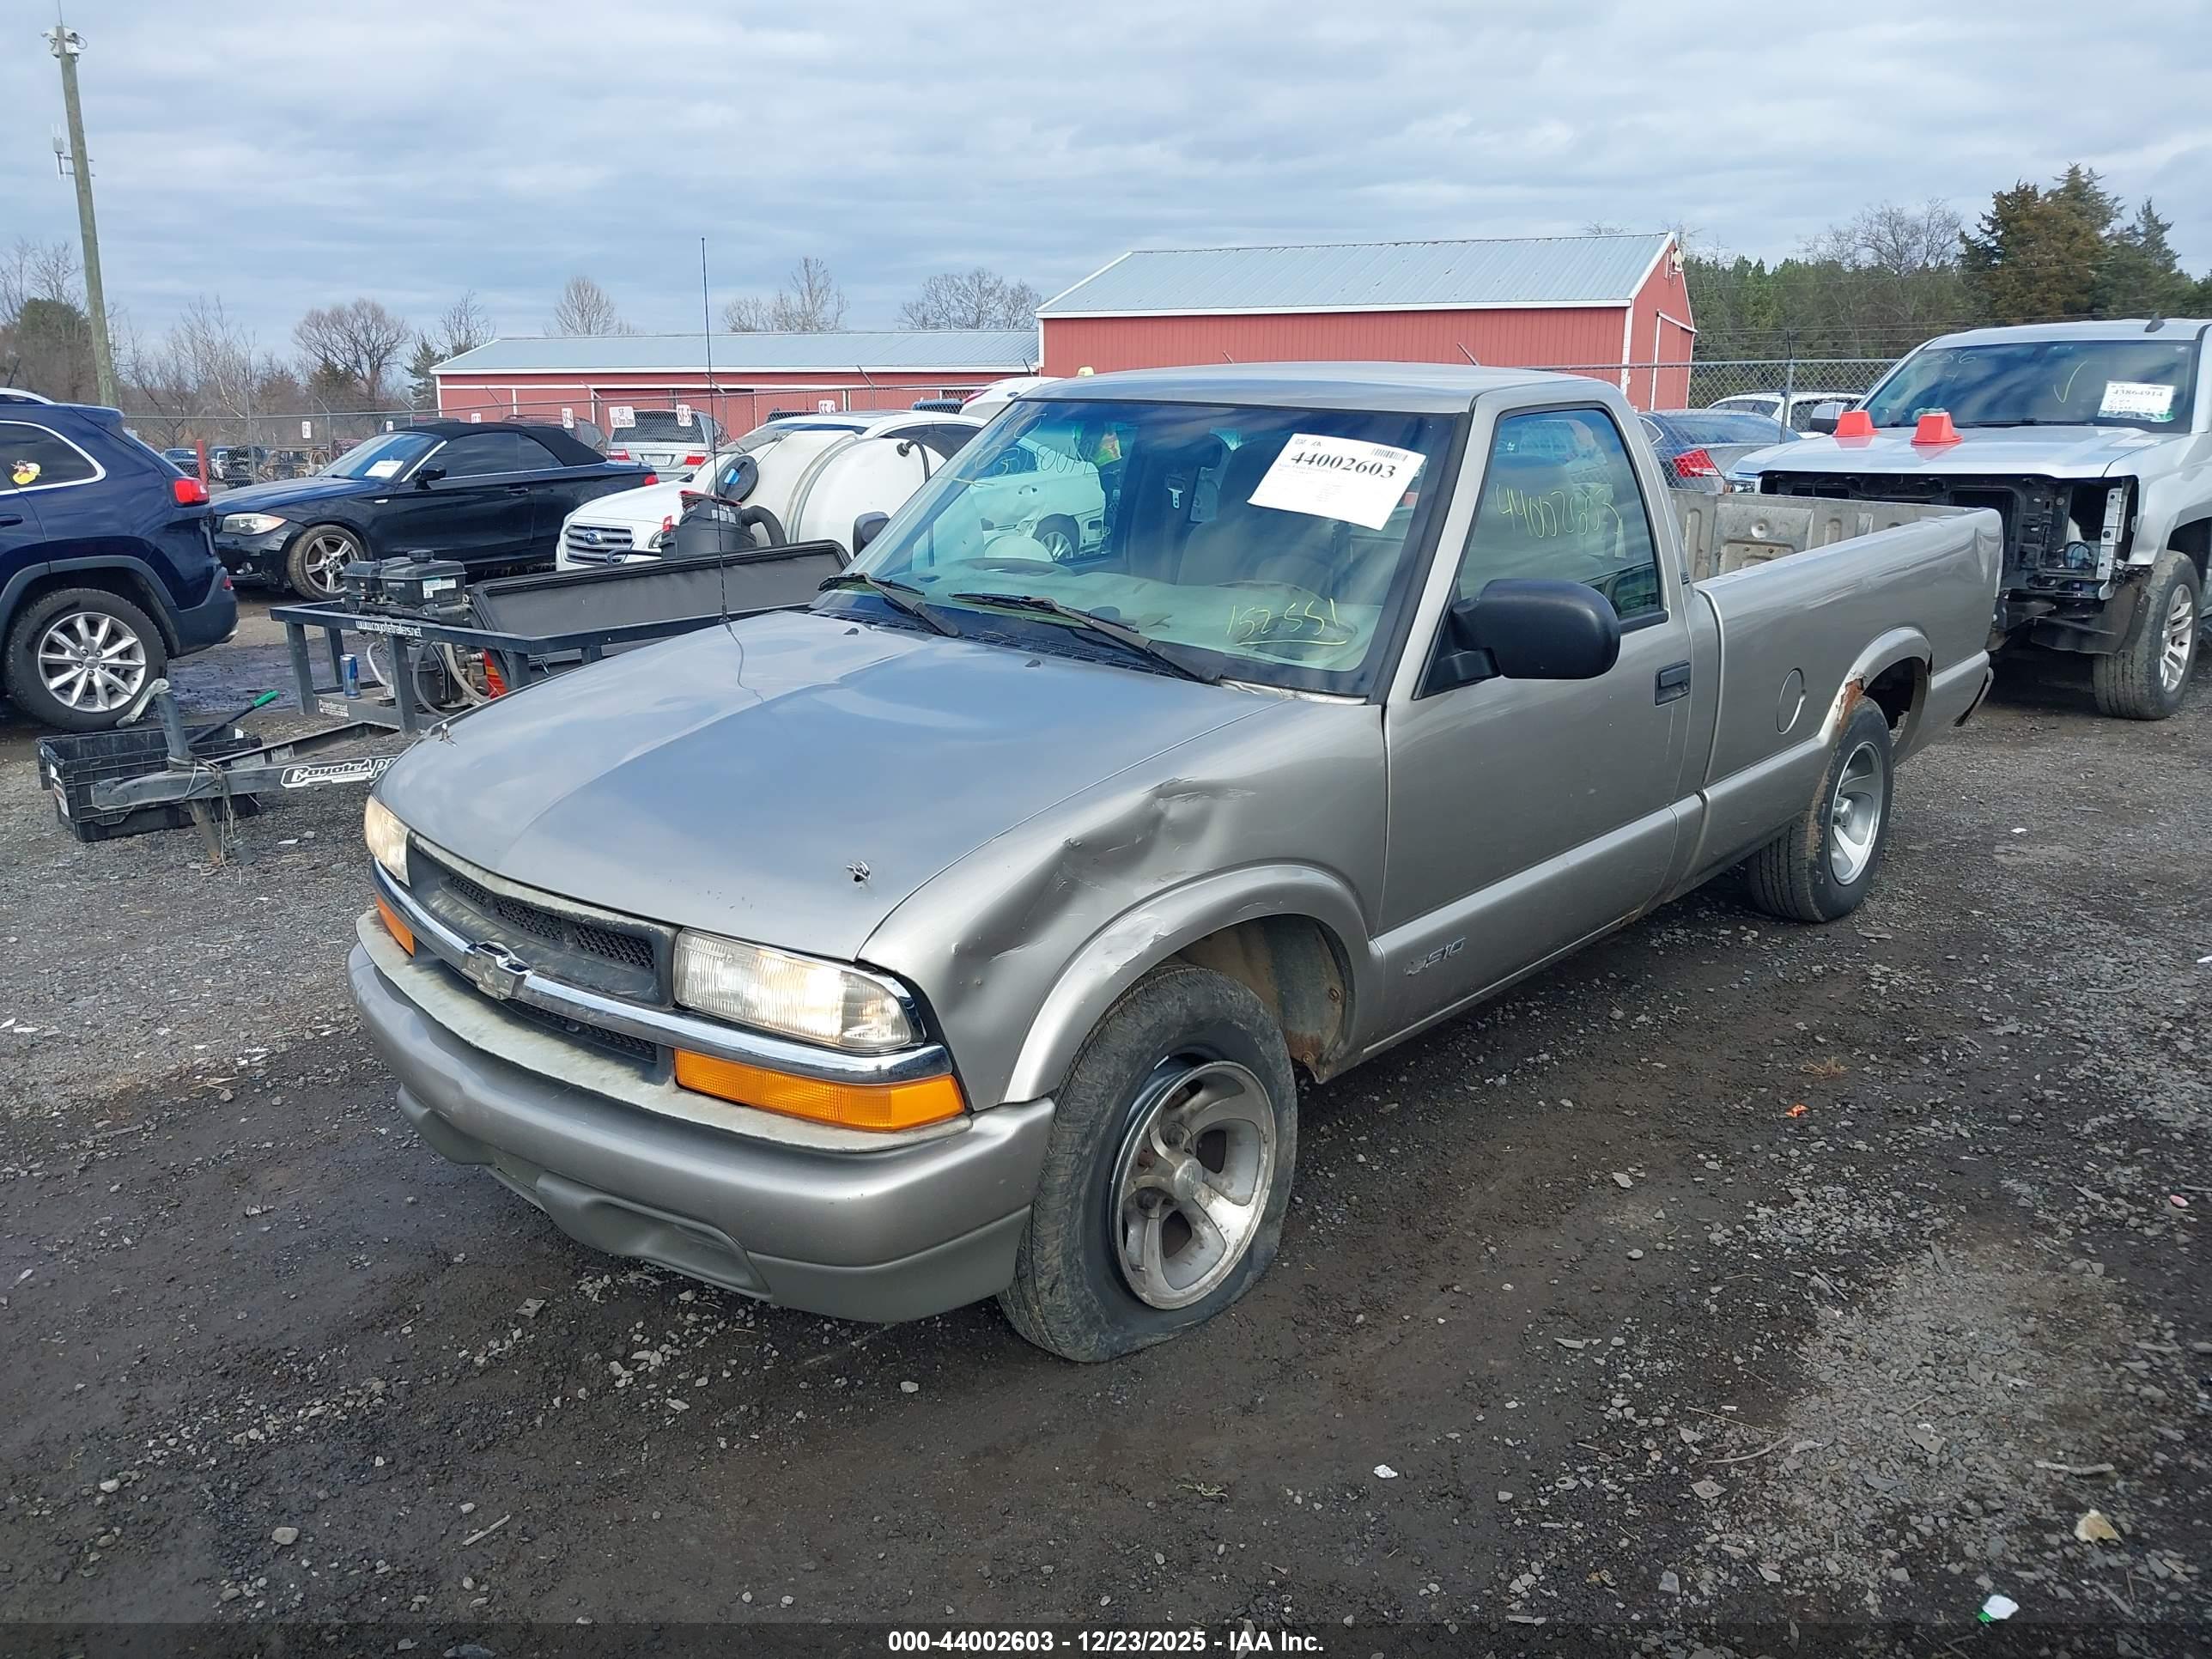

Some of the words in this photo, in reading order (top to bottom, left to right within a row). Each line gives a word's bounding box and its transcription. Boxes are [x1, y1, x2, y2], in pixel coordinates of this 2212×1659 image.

[678, 407, 690, 423] SF-5
[1291, 451, 1397, 479] 44002603
[281, 762, 362, 787] Coyote
